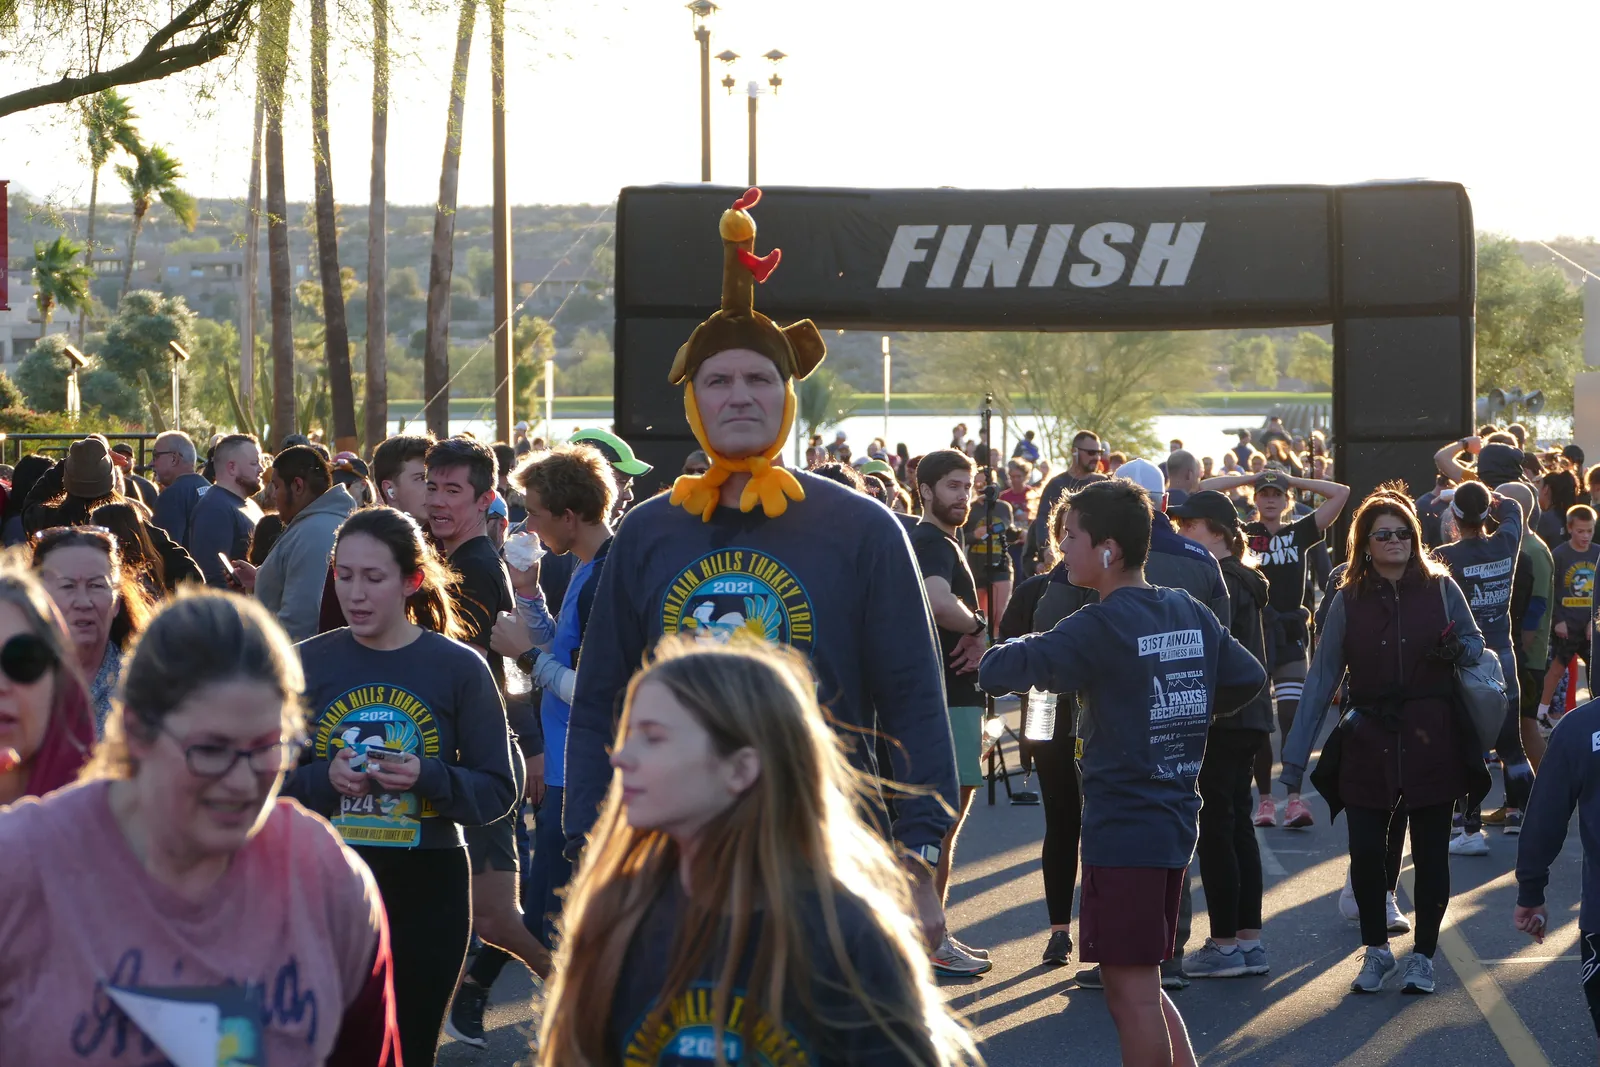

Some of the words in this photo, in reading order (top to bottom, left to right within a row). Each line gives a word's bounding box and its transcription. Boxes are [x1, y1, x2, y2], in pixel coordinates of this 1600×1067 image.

[876, 221, 1206, 288] FINISH
[1256, 546, 1299, 566] OWN
[713, 581, 754, 593] 2021
[663, 569, 701, 634] OUNTAIN
[700, 551, 743, 578] HILLS
[748, 553, 802, 600] TURKEY
[788, 601, 812, 642] TROT
[1141, 636, 1164, 652] 31ST
[1189, 647, 1203, 656] WALK
[1187, 670, 1203, 678] HILLS
[348, 686, 385, 708] HILLS
[388, 688, 433, 725] TURKEY
[1168, 689, 1202, 706] PARKS
[360, 711, 394, 721] 2021
[1150, 703, 1207, 720] RECREATION
[1150, 732, 1175, 744] RE/MAX
